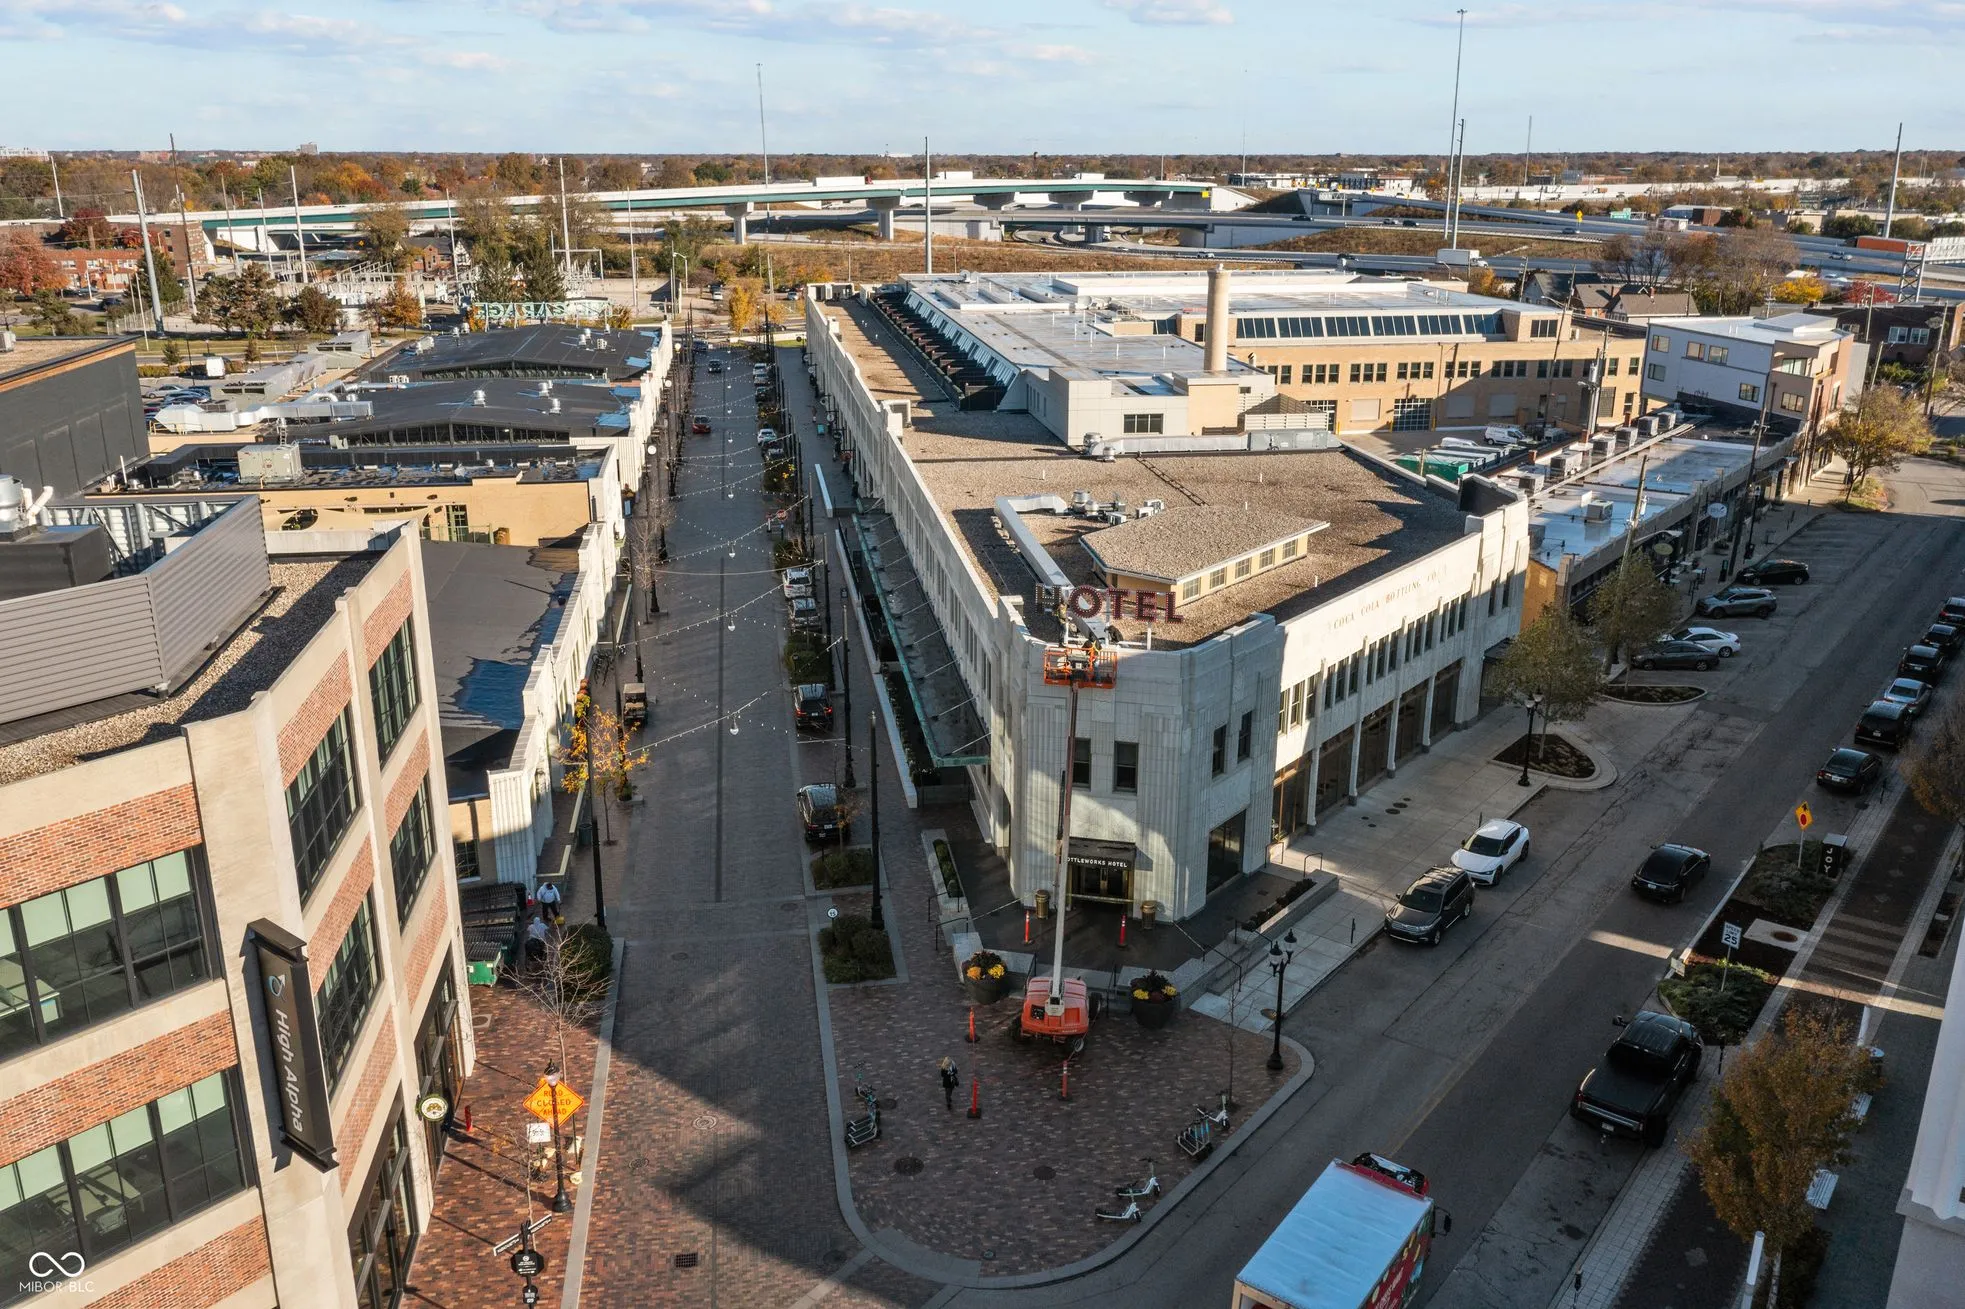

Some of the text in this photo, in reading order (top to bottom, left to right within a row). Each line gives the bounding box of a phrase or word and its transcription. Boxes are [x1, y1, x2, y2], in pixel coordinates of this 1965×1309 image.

[1035, 583, 1184, 624] HOTEL
[1067, 857, 1106, 866] OTTLEWORKS
[1823, 847, 1834, 873] JOY
[1724, 934, 1738, 945] 25
[275, 1008, 303, 1133] High Alpha
[543, 1108, 567, 1116] AHAD
